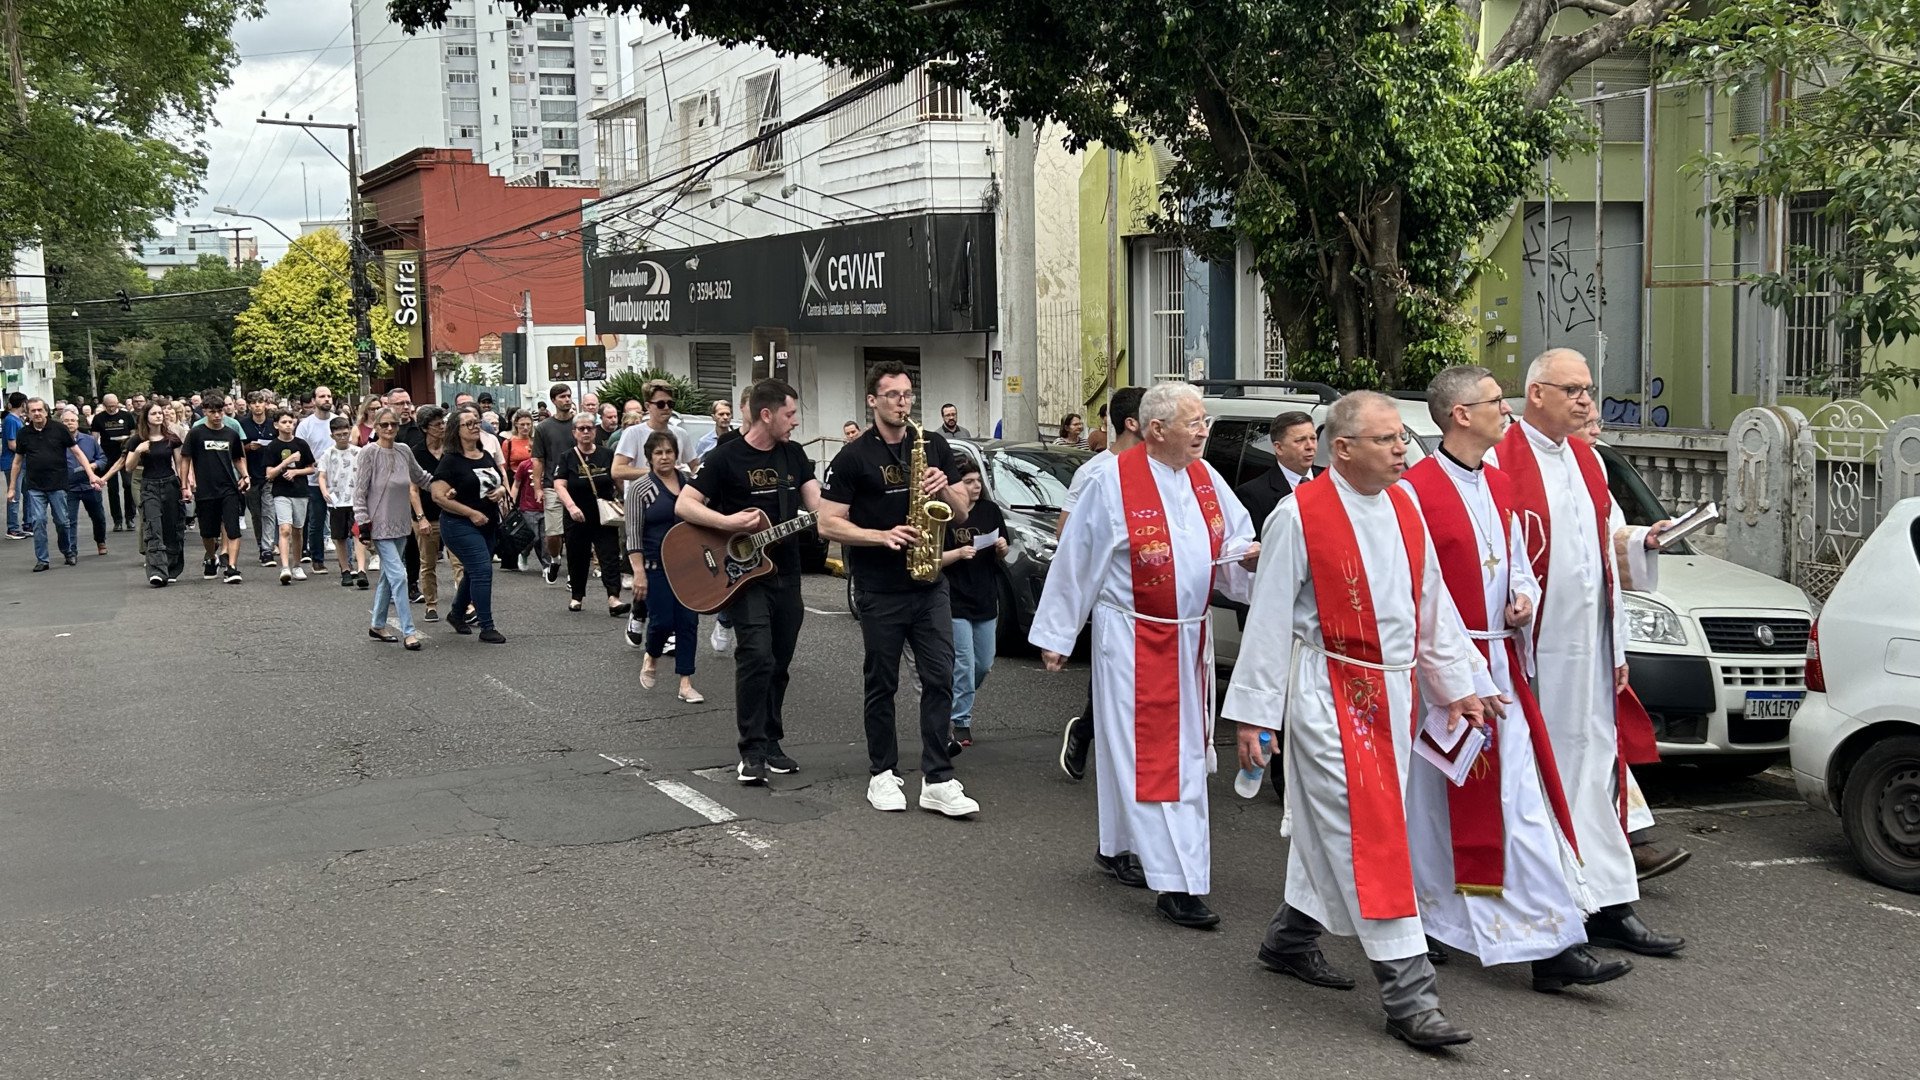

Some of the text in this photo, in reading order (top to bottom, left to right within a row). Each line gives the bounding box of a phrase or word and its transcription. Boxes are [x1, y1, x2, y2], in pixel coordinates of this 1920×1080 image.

[609, 266, 648, 288] Autolocadora
[394, 260, 418, 325] Safra
[697, 280, 732, 301] 3594-3622
[608, 294, 671, 329] Hamburguesa
[807, 300, 887, 317] Central de Vendas de Vales Transporte
